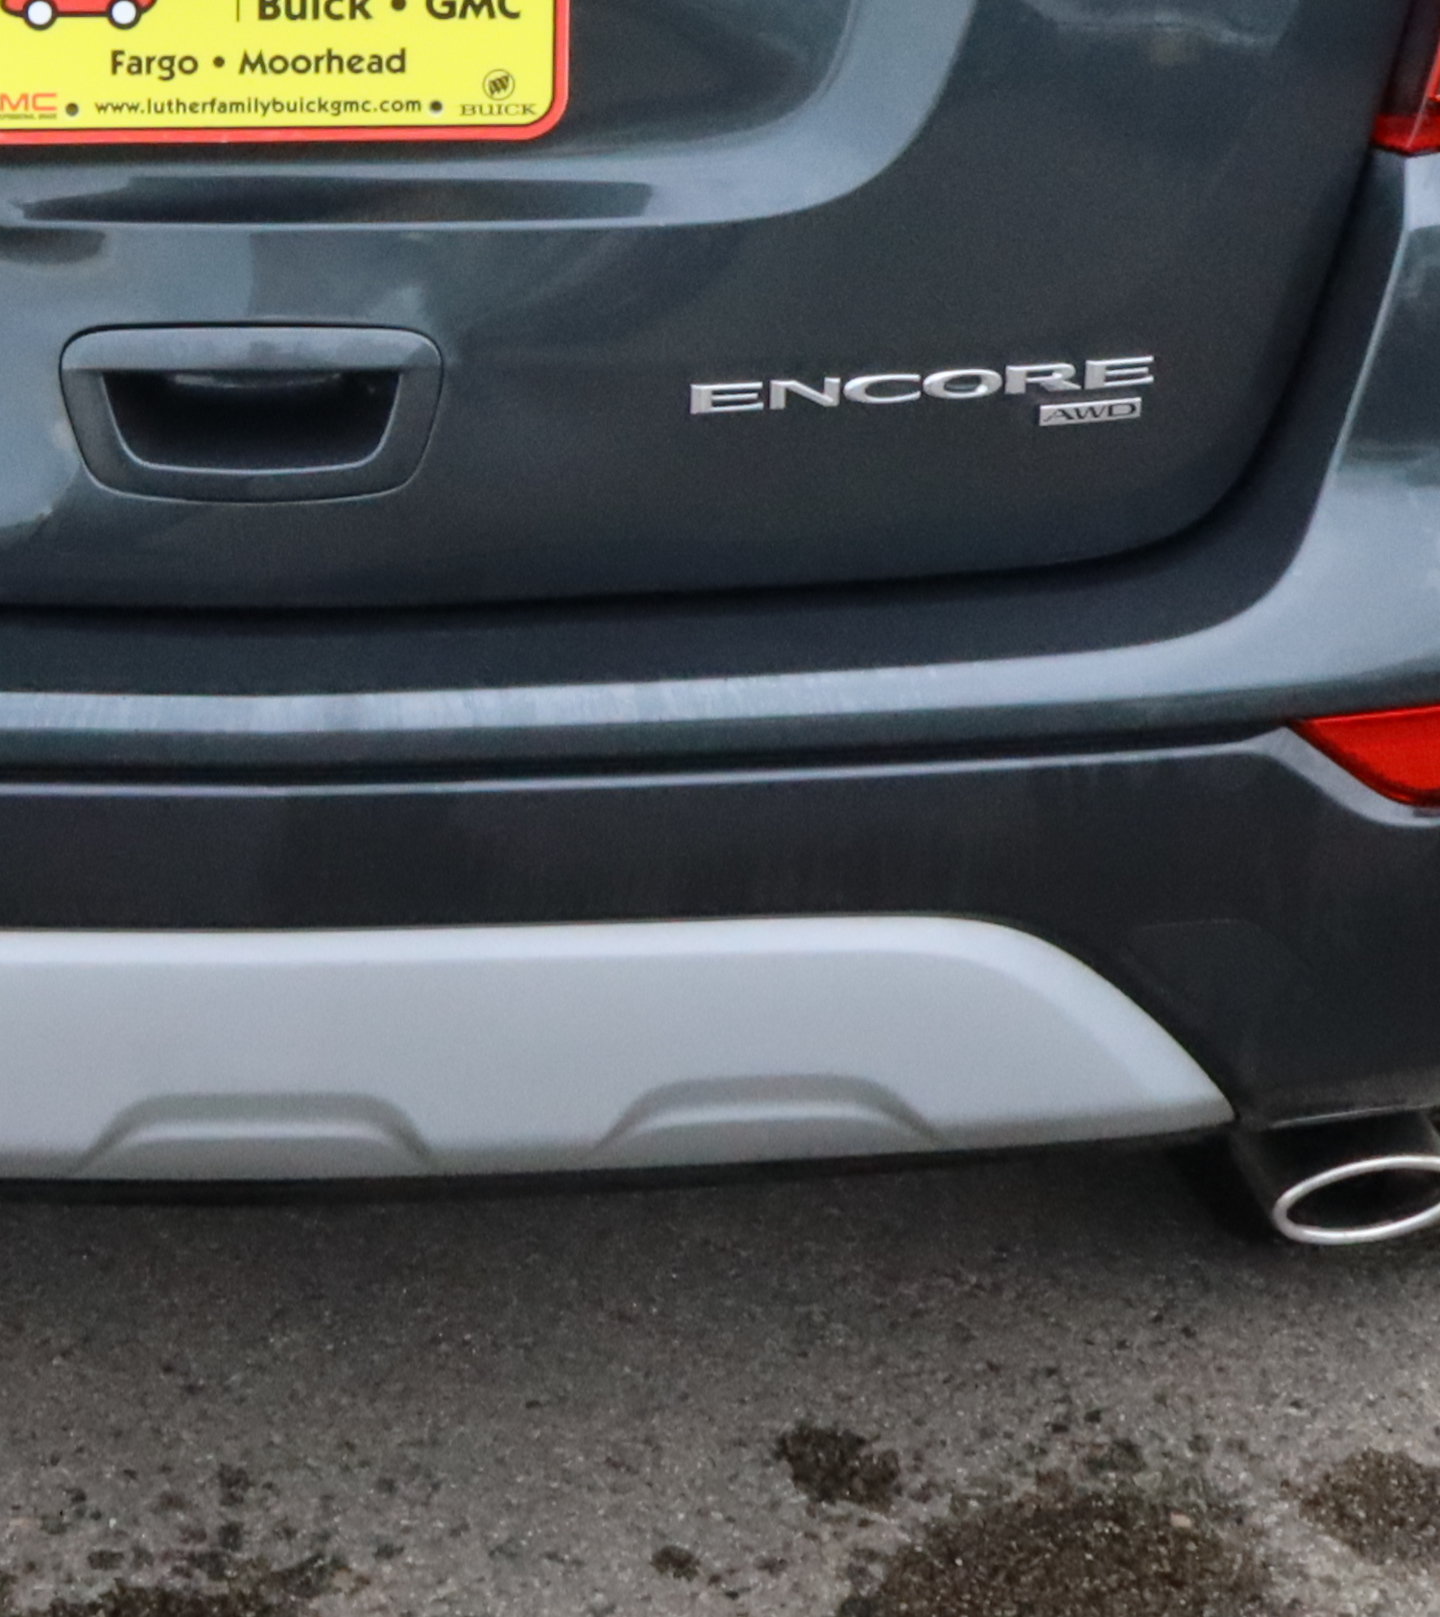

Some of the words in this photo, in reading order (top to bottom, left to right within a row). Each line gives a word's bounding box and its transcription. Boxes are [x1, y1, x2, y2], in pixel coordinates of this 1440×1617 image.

[110, 50, 199, 81] Fargo
[238, 48, 407, 76] Moorhead
[94, 96, 422, 117] www.lutherfamilybuickgmc.com
[459, 103, 538, 117] BUICK
[690, 355, 1154, 415] ENCORE
[1042, 400, 1137, 424] AWD
